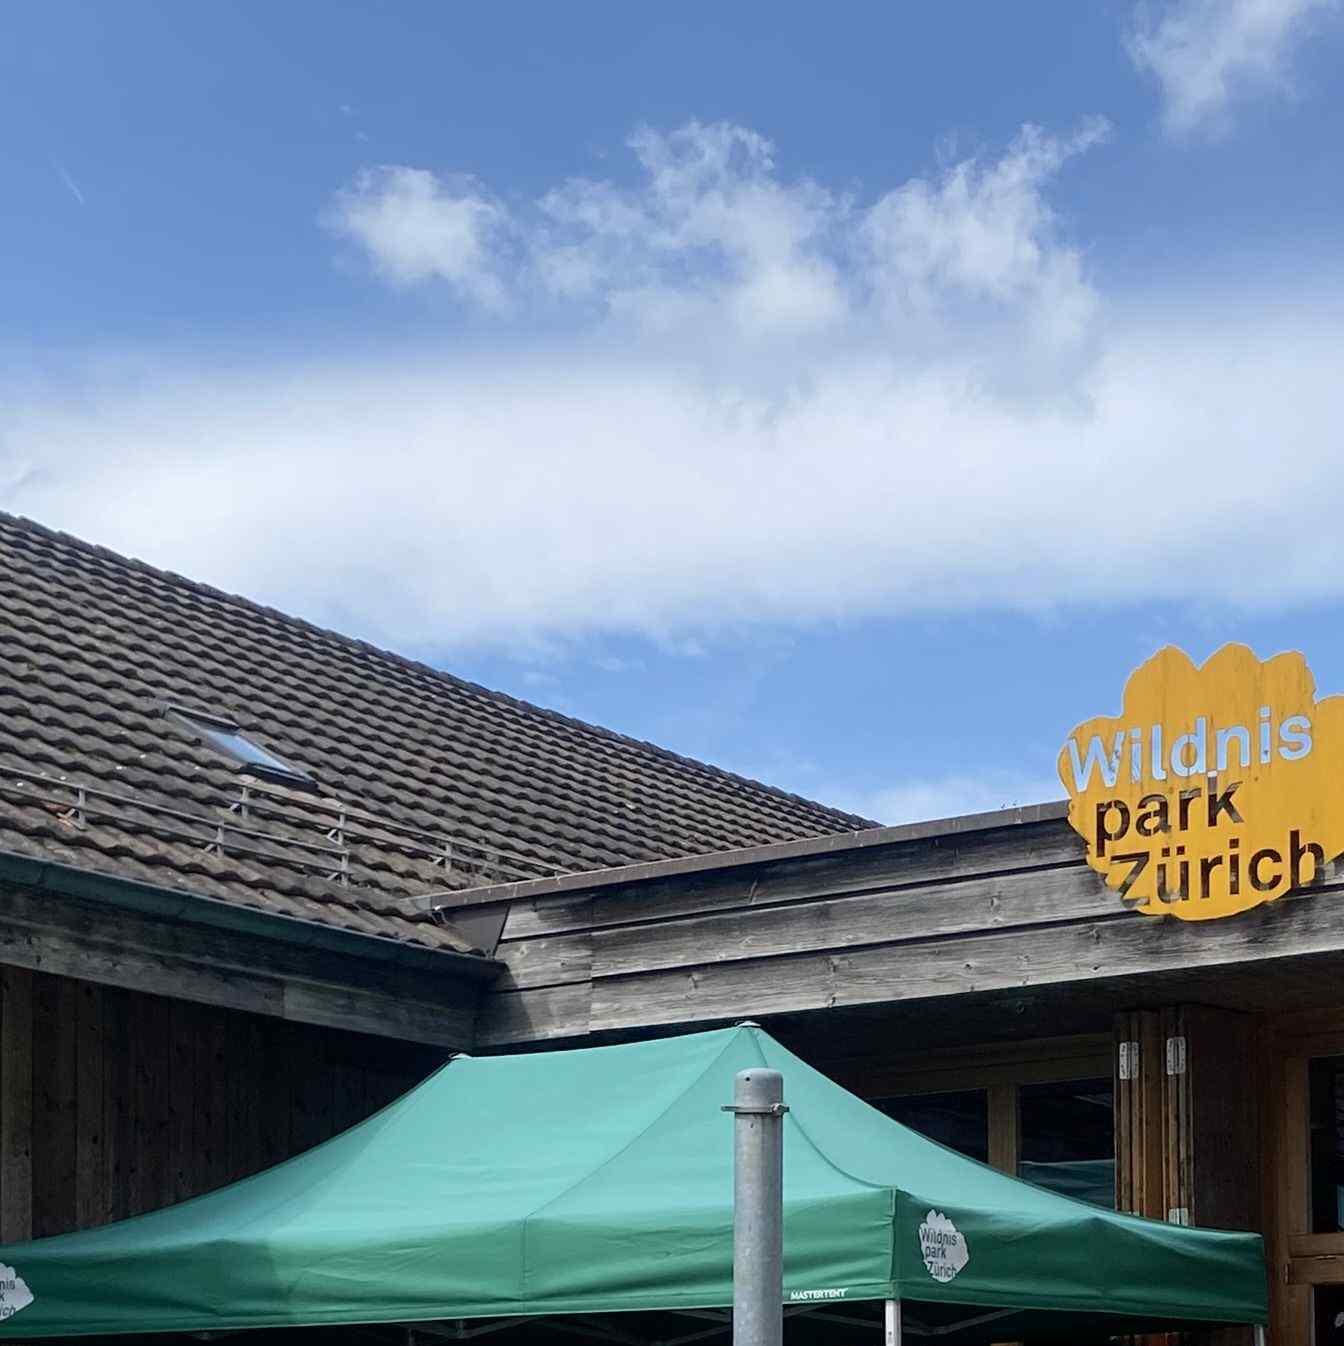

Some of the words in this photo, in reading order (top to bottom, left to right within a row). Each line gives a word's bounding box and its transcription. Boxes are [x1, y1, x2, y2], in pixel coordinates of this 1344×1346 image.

[1067, 704, 1312, 792] Wildnis
[1096, 769, 1244, 857] park
[1111, 829, 1325, 909] Zürich
[921, 1227, 957, 1246] Wildnis
[925, 1244, 946, 1259] park
[927, 1261, 957, 1279] Zürich
